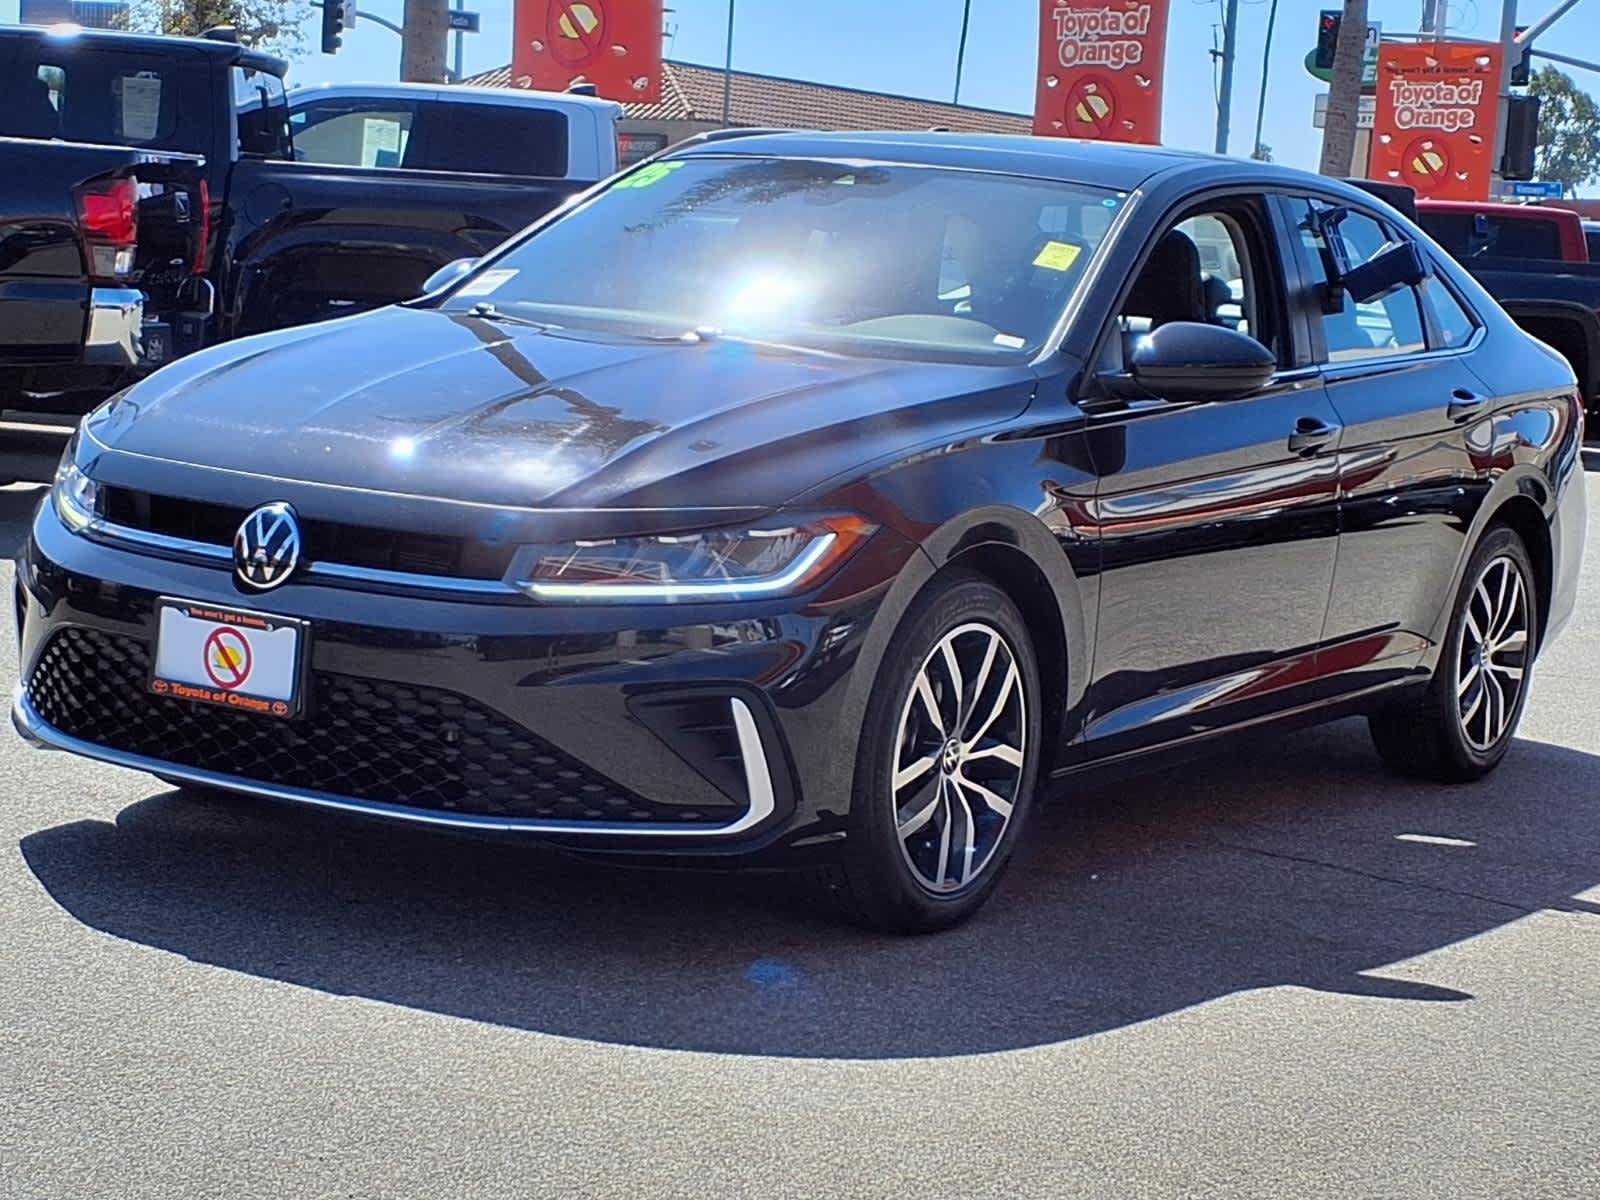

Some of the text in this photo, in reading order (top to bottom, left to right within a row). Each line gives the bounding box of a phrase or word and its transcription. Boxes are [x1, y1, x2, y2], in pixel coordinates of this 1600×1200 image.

[1053, 5, 1151, 40] Toyota of
[1058, 38, 1143, 69] Orange
[1390, 79, 1483, 107] Toyota of
[1394, 104, 1475, 132] Orange
[170, 682, 270, 711] Toyota of Orange
